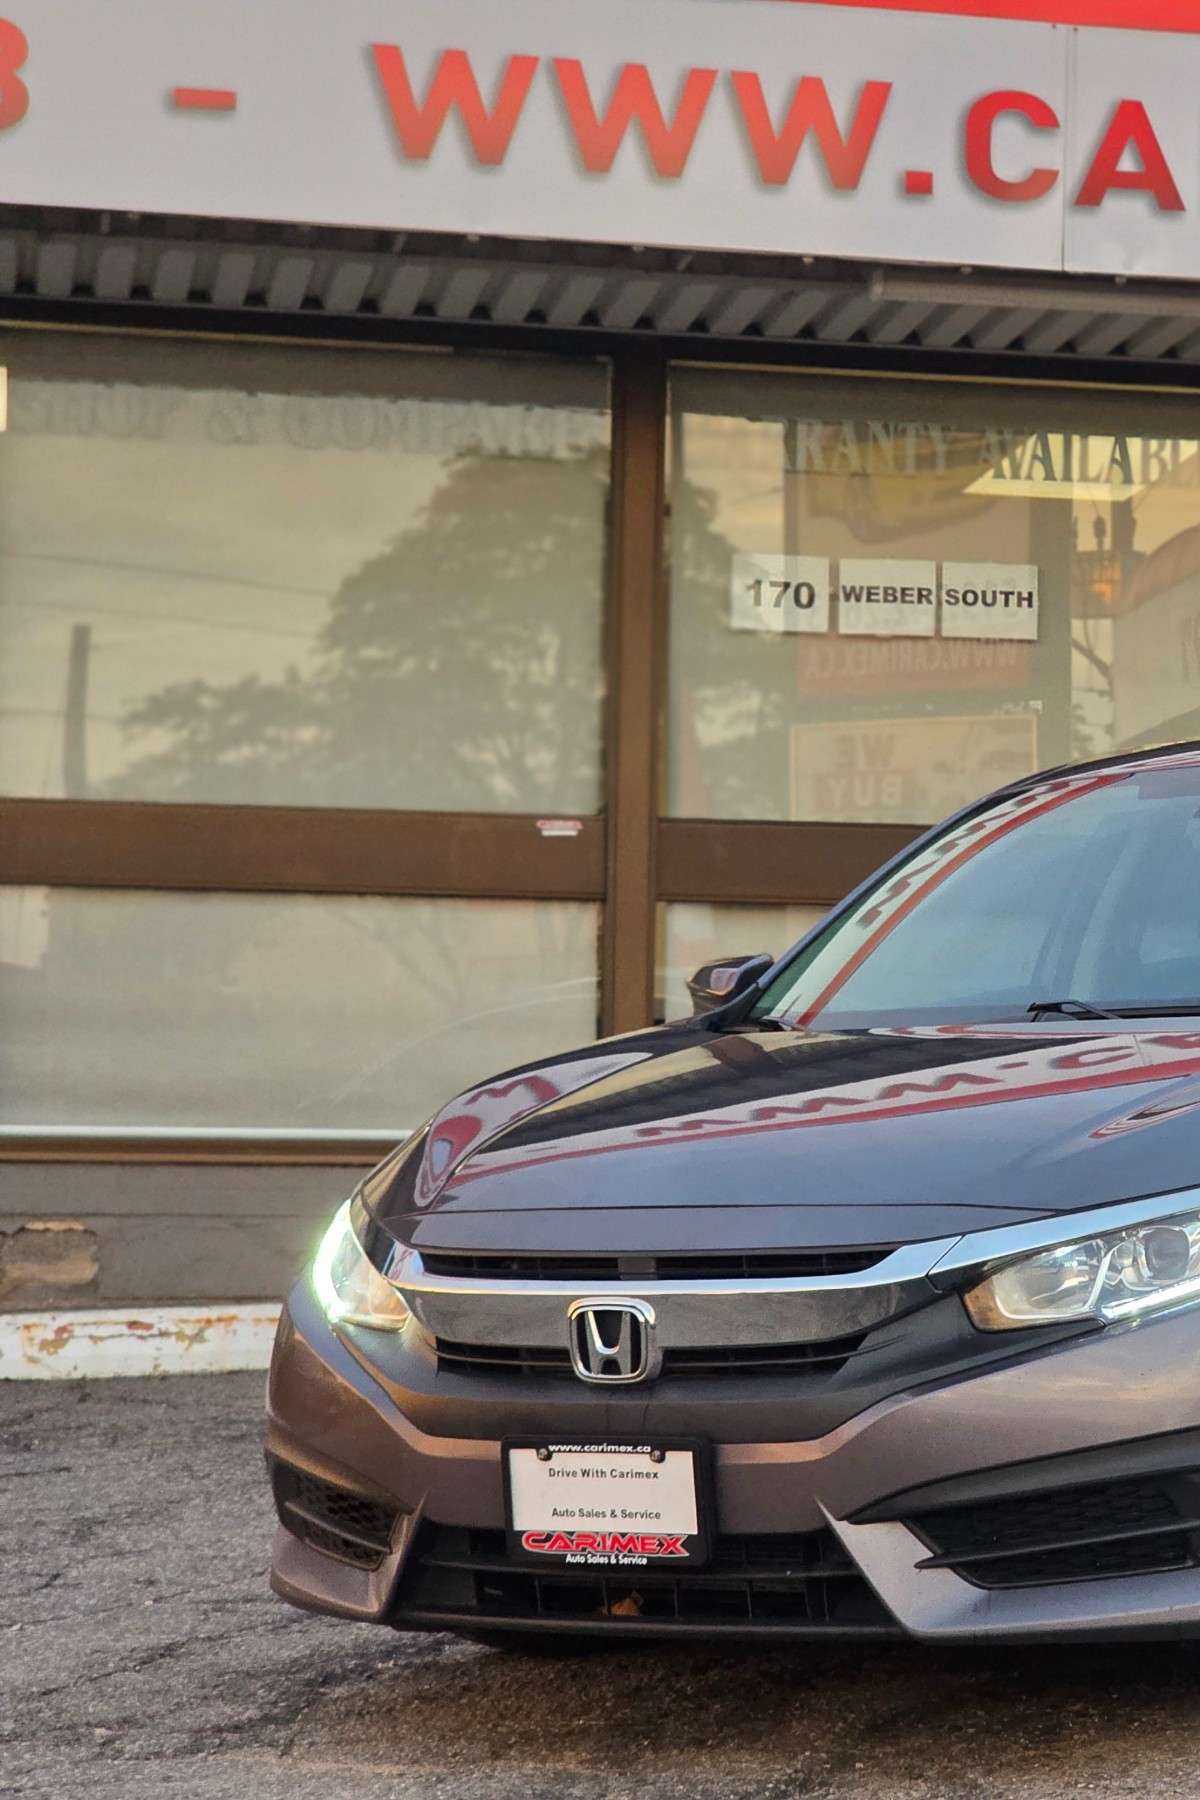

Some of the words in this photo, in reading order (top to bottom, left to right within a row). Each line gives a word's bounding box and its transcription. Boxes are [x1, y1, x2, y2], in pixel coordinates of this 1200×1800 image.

[745, 579, 817, 612] 170
[841, 584, 934, 606] WEBER
[944, 588, 1035, 610] SOUTH
[548, 1443, 652, 1454] www.carimex.ca
[549, 1467, 578, 1479] Drive
[581, 1468, 607, 1479] With
[610, 1469, 659, 1480] Carimex
[552, 1507, 576, 1518] Auto
[578, 1508, 607, 1519] Sales
[609, 1509, 618, 1519] &
[620, 1509, 661, 1520] Service
[522, 1531, 690, 1557] CARIMEX
[566, 1554, 586, 1564] Auto
[587, 1554, 609, 1564] Sales
[610, 1555, 617, 1565] &
[618, 1555, 648, 1566] Service
